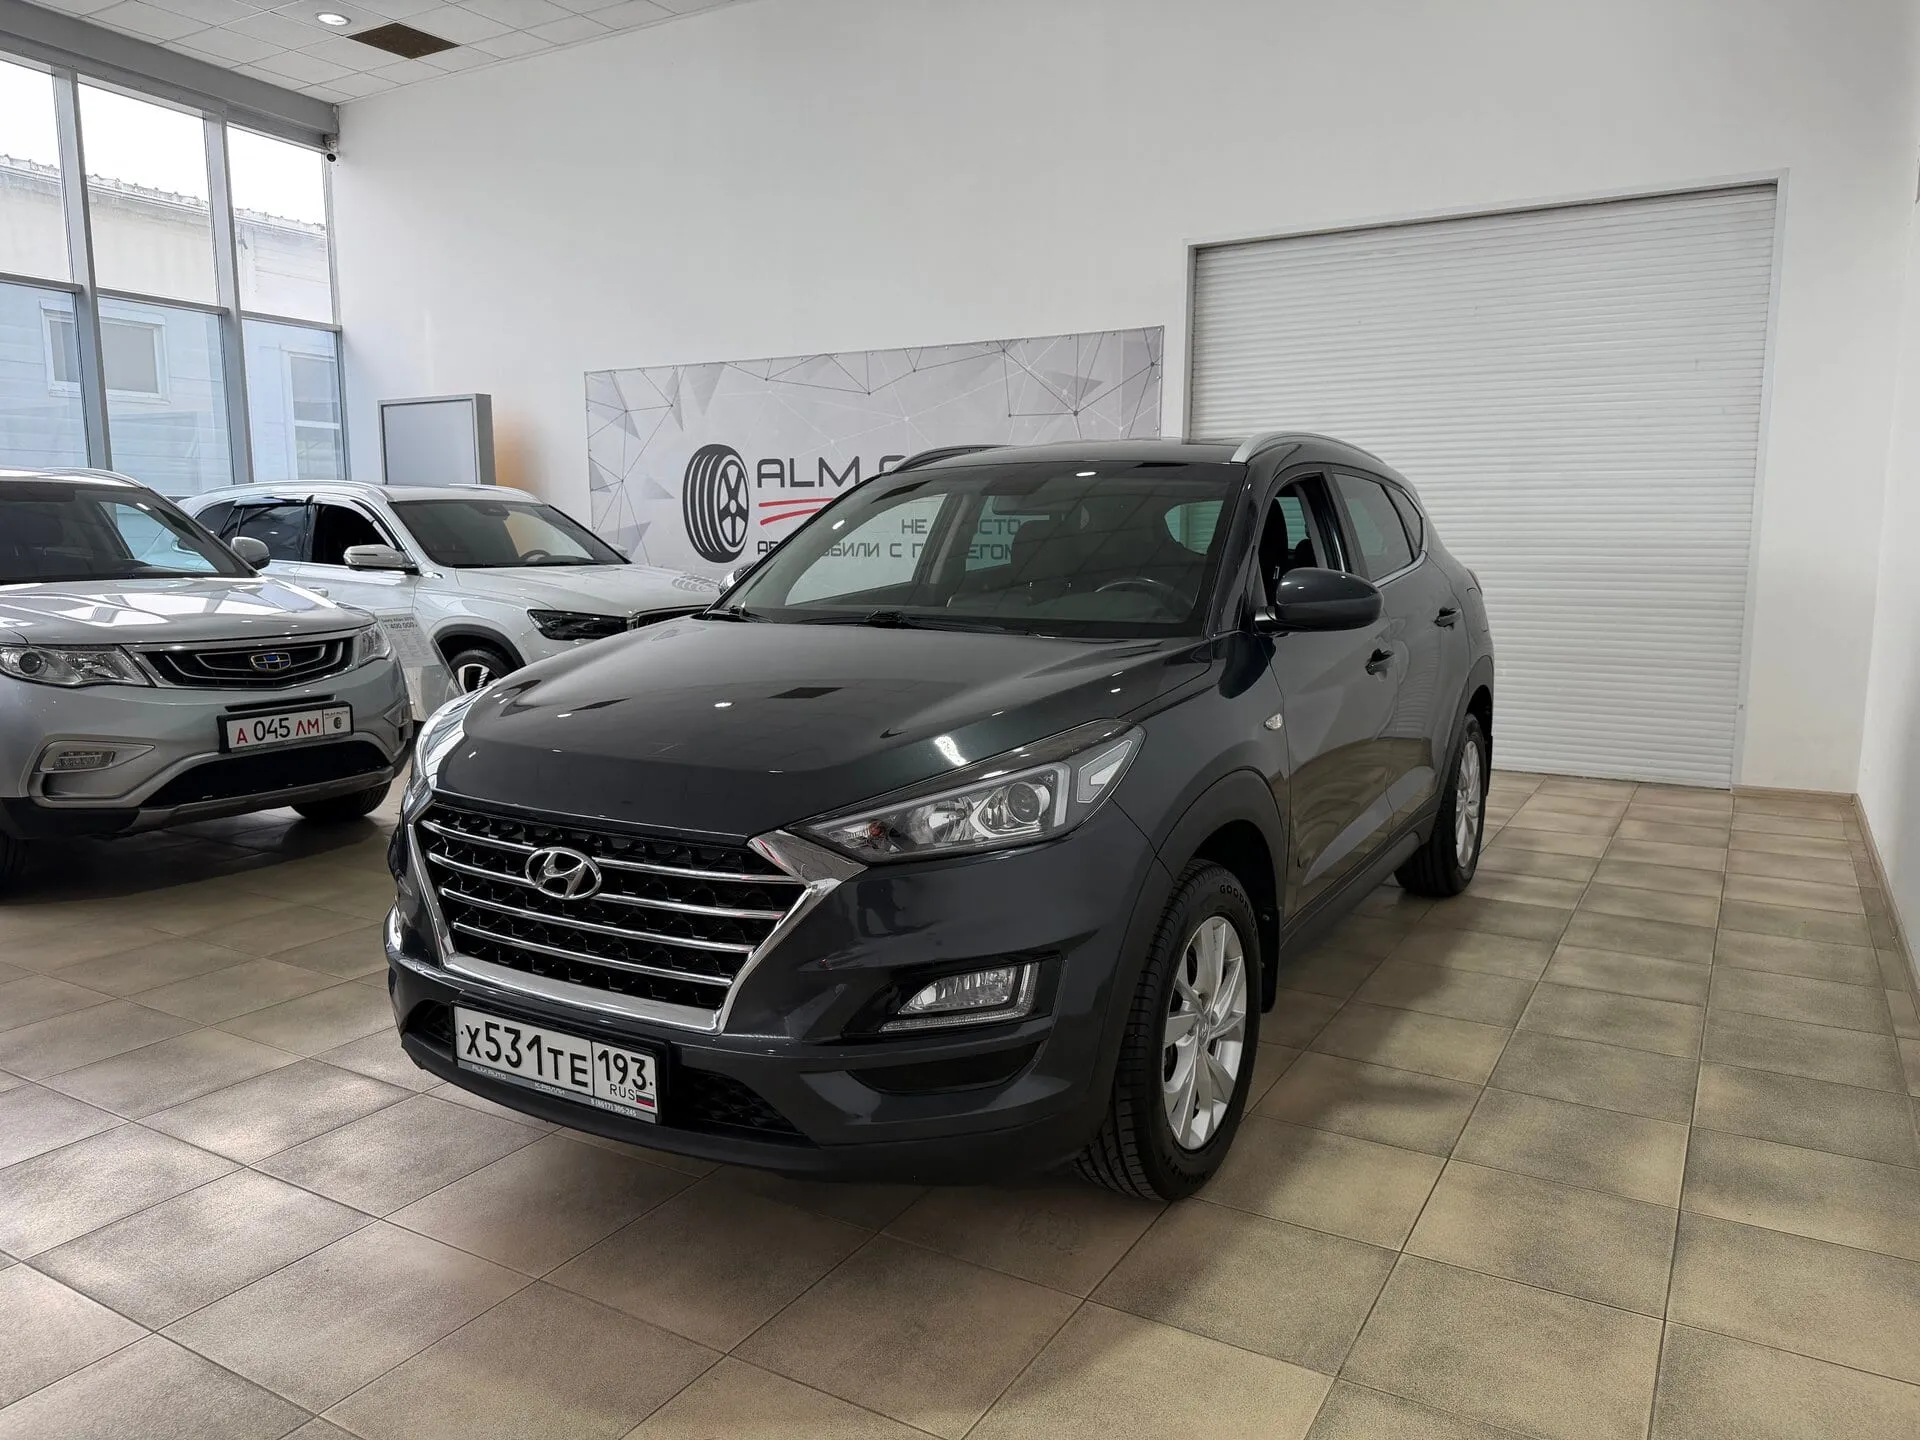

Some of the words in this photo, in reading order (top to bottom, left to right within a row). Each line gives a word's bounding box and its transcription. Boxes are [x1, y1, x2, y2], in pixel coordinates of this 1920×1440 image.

[757, 456, 860, 488] ALM
[902, 519, 927, 534] НЕ
[253, 717, 291, 742] 045
[598, 1049, 647, 1091] 193
[609, 1083, 636, 1100] RUS
